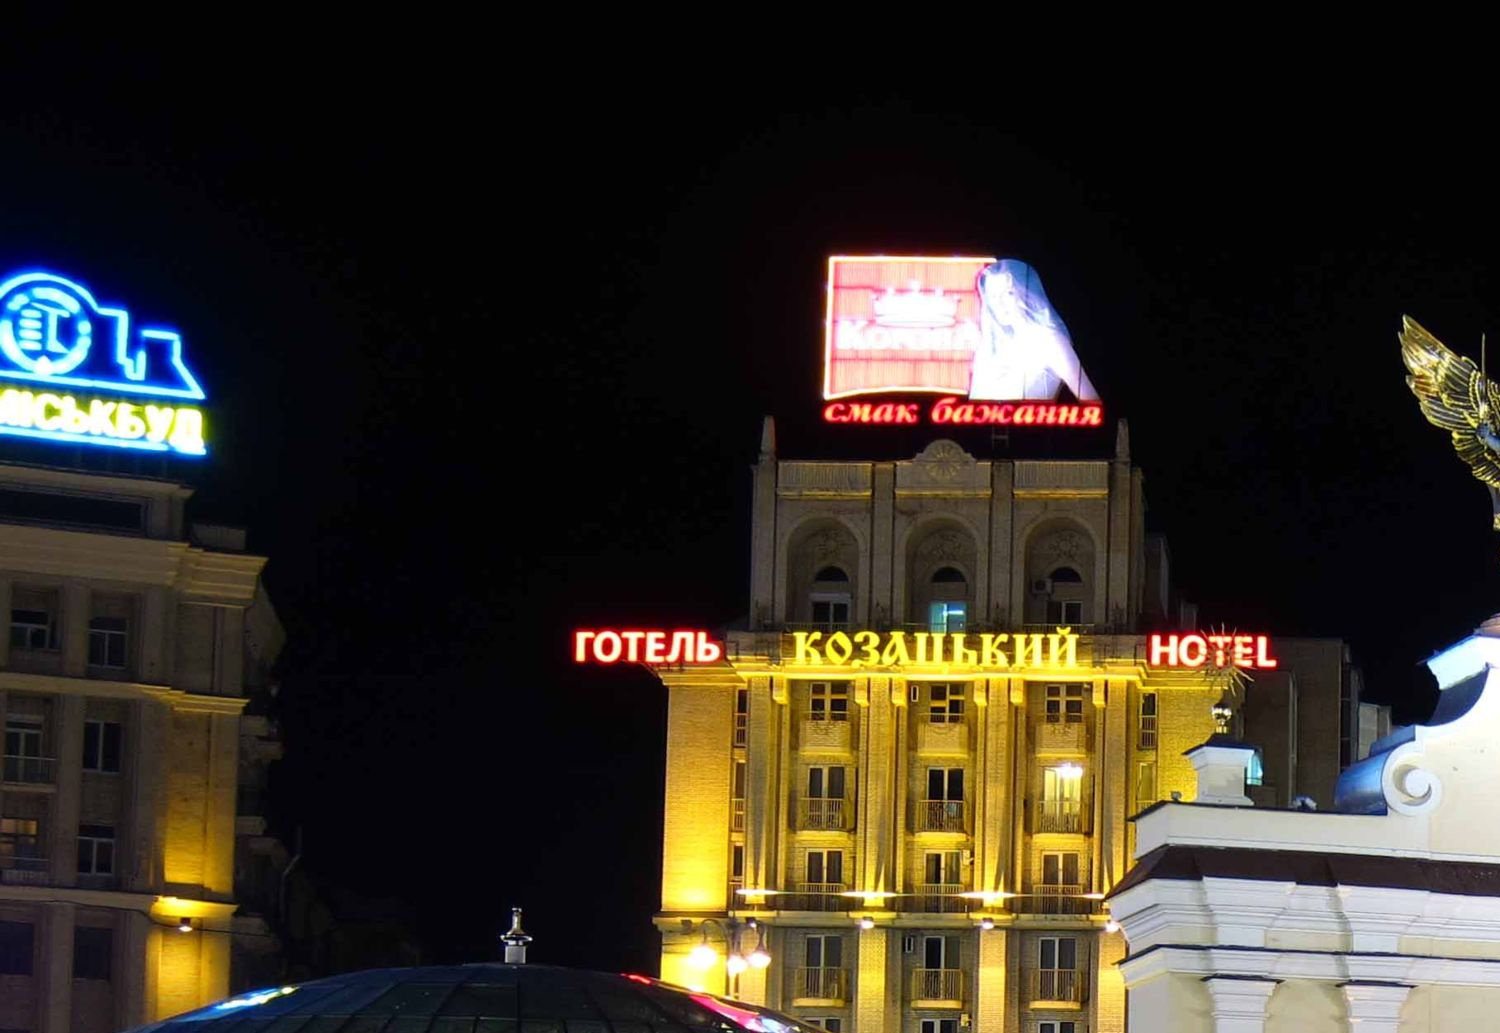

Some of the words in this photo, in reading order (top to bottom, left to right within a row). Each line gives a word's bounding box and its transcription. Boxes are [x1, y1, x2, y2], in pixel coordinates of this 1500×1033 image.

[824, 402, 918, 424] смак
[931, 396, 1102, 426] бажання
[575, 631, 720, 662] ГОТЕЛЬ
[792, 626, 1080, 668] КОЗАЦЬКИЙ
[1151, 634, 1277, 667] HOTEL
